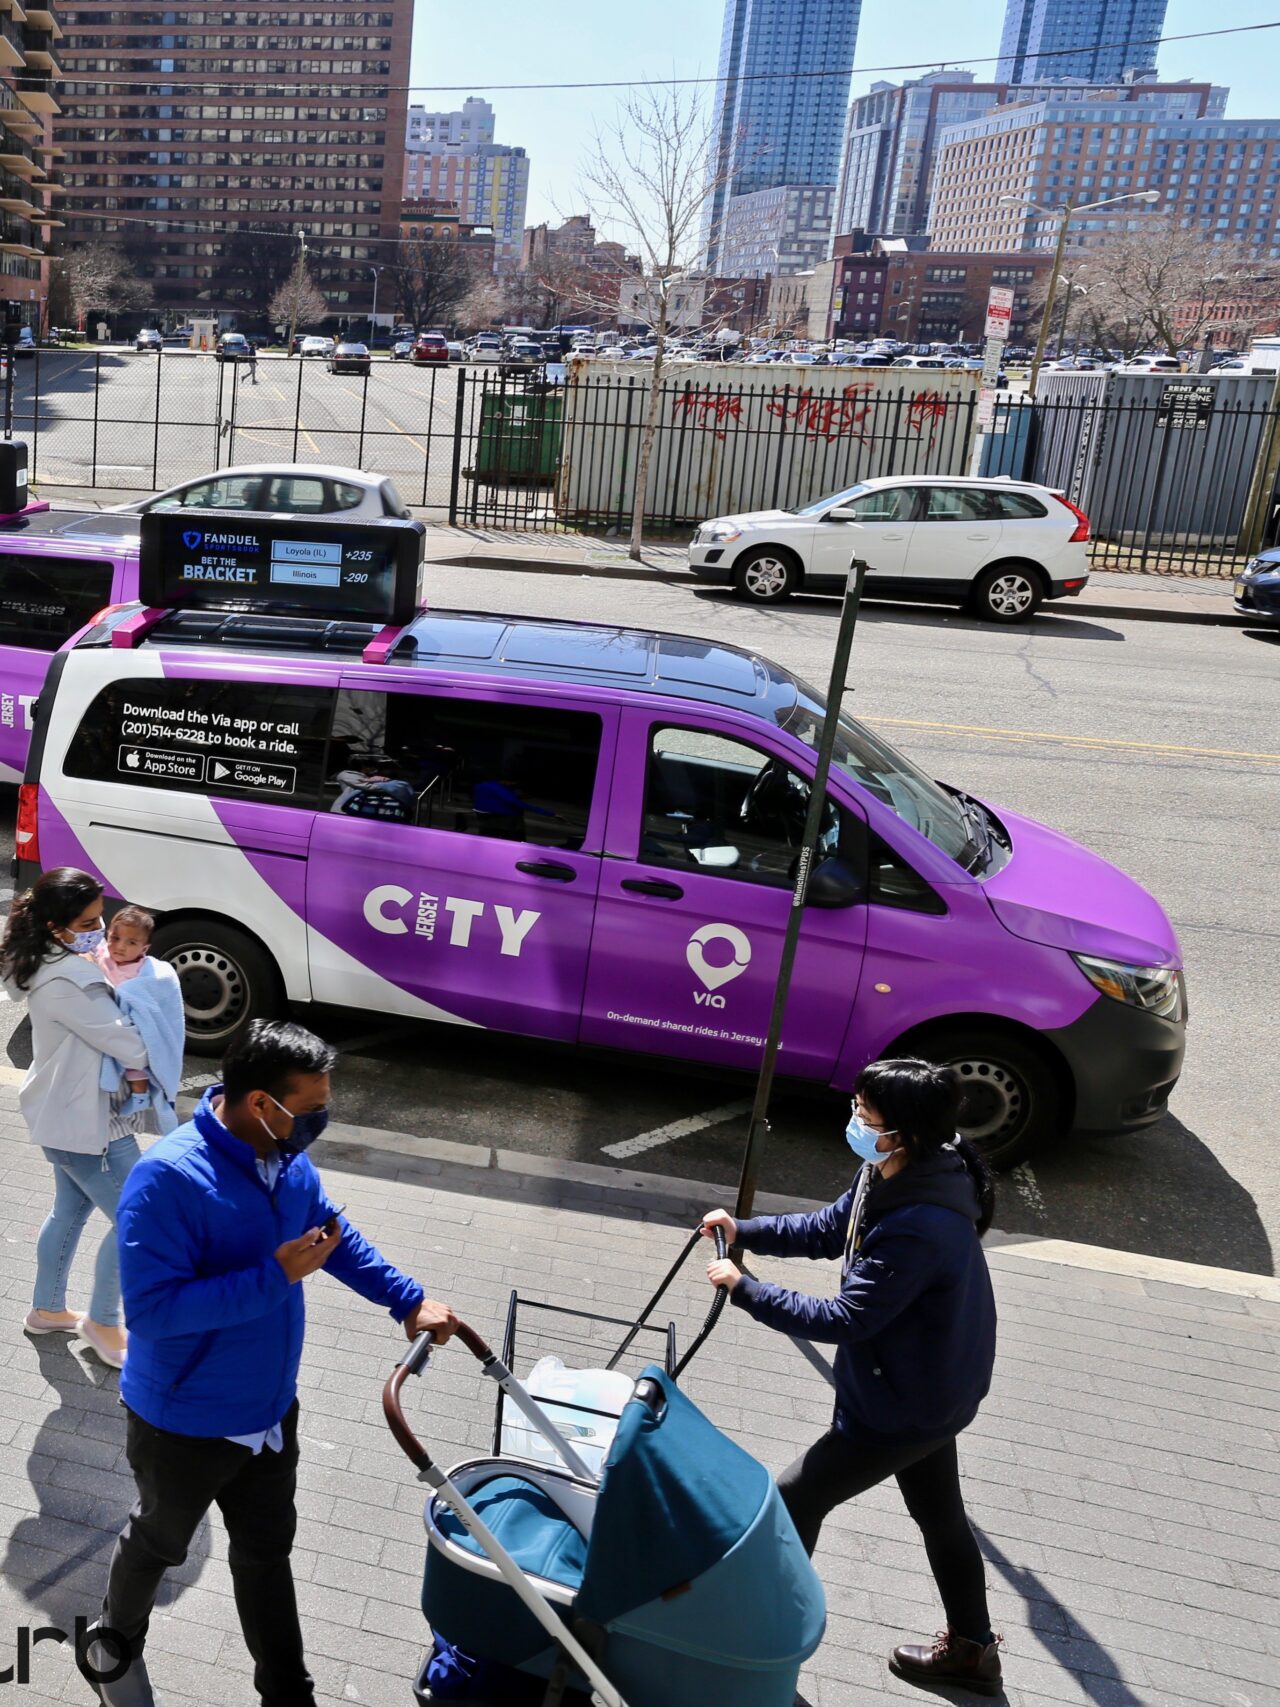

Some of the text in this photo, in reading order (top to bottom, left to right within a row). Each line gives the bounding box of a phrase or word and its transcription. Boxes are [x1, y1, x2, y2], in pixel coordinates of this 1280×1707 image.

[204, 534, 260, 546] FANDUEL
[286, 546, 326, 558] Loyola (IL)
[345, 551, 372, 561] +235
[201, 556, 237, 566] BET THE
[184, 564, 256, 582] BRACKET
[292, 570, 317, 579] Illinois
[343, 573, 368, 583] -290
[1, 693, 14, 728] JERSEY
[123, 703, 299, 736] Download the Via app or call
[121, 720, 298, 754] (201)514-6228 to book a ride.
[145, 752, 176, 762] Download
[144, 760, 196, 776] App Store
[234, 771, 287, 788] Google Play
[415, 892, 439, 940] JERSEY
[607, 1011, 659, 1027] On-demand
[662, 1020, 693, 1033] shared
[695, 1026, 718, 1037] rides
[720, 1030, 729, 1039] in
[730, 1032, 762, 1046] Jersey
